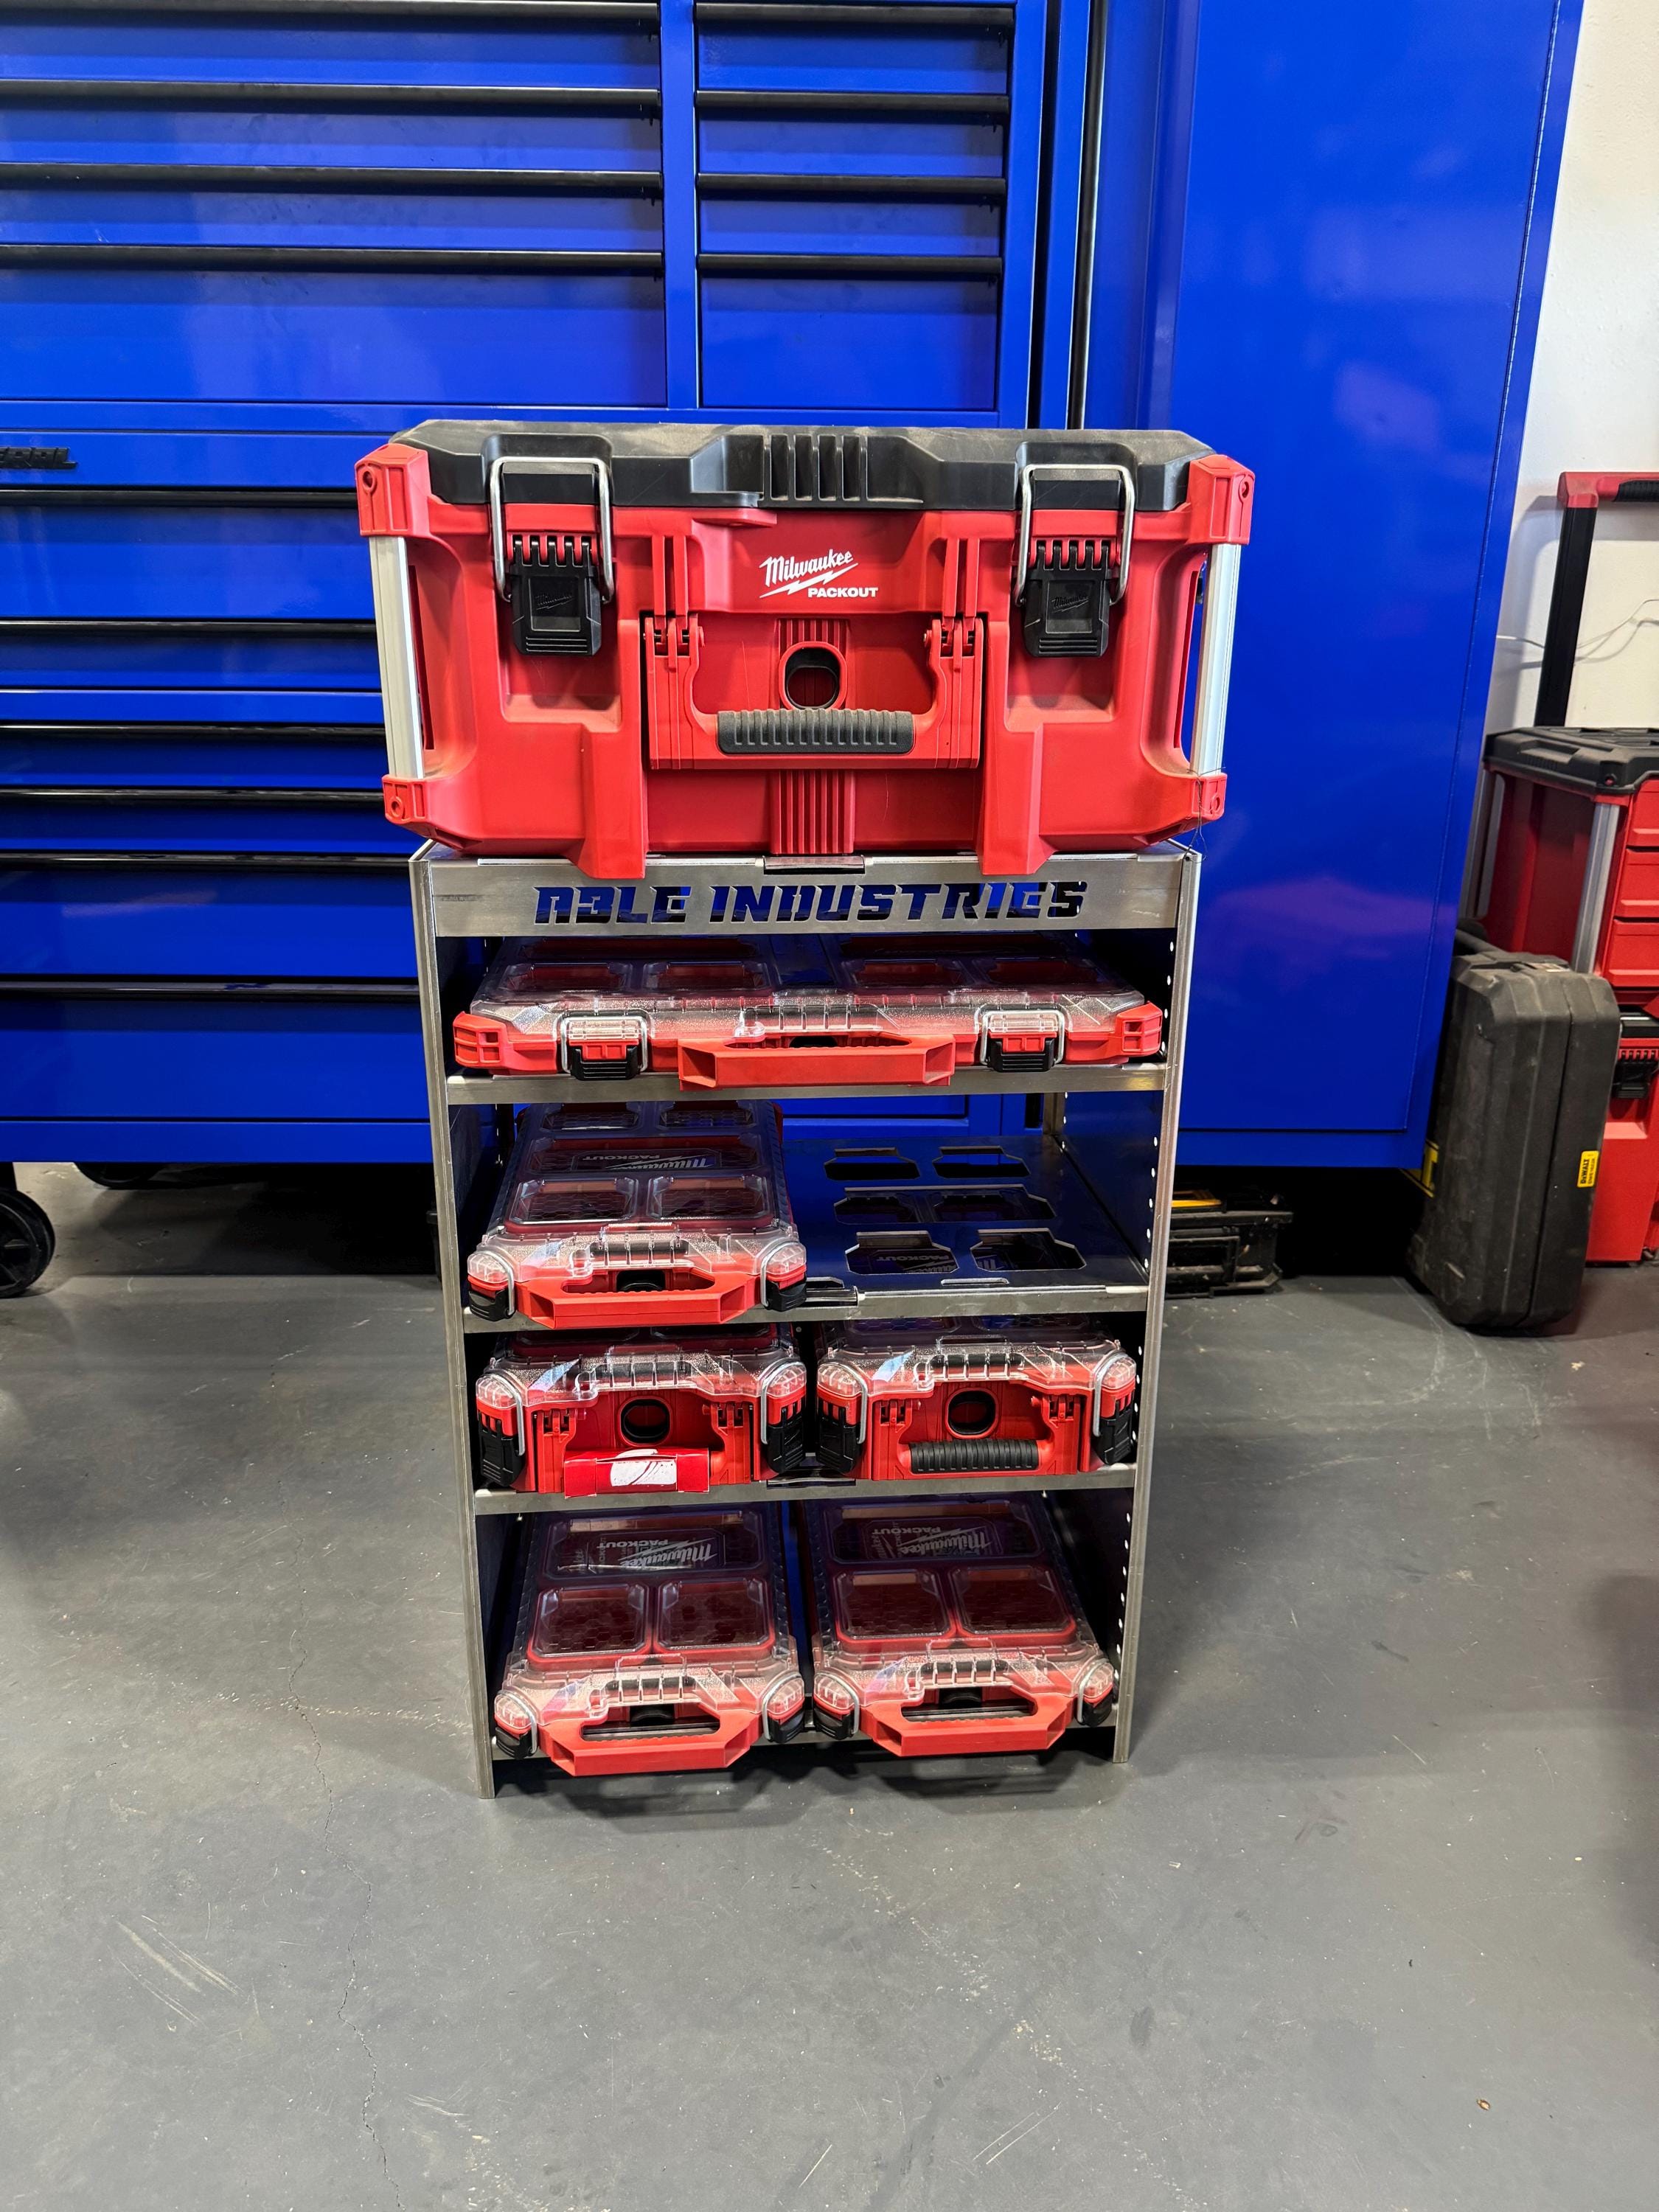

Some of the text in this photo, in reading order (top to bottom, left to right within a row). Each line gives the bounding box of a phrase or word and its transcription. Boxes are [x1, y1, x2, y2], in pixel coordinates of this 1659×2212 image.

[759, 549, 854, 588] Milwaukee
[807, 588, 879, 598] PACKOUT
[532, 881, 1088, 925] ABLE INDUSTRIES
[872, 1526, 942, 1535] PACKOUT
[597, 1540, 669, 1549] PACKOUT
[617, 1543, 718, 1571] Milwaukee
[897, 1531, 993, 1557] Milwaukee
